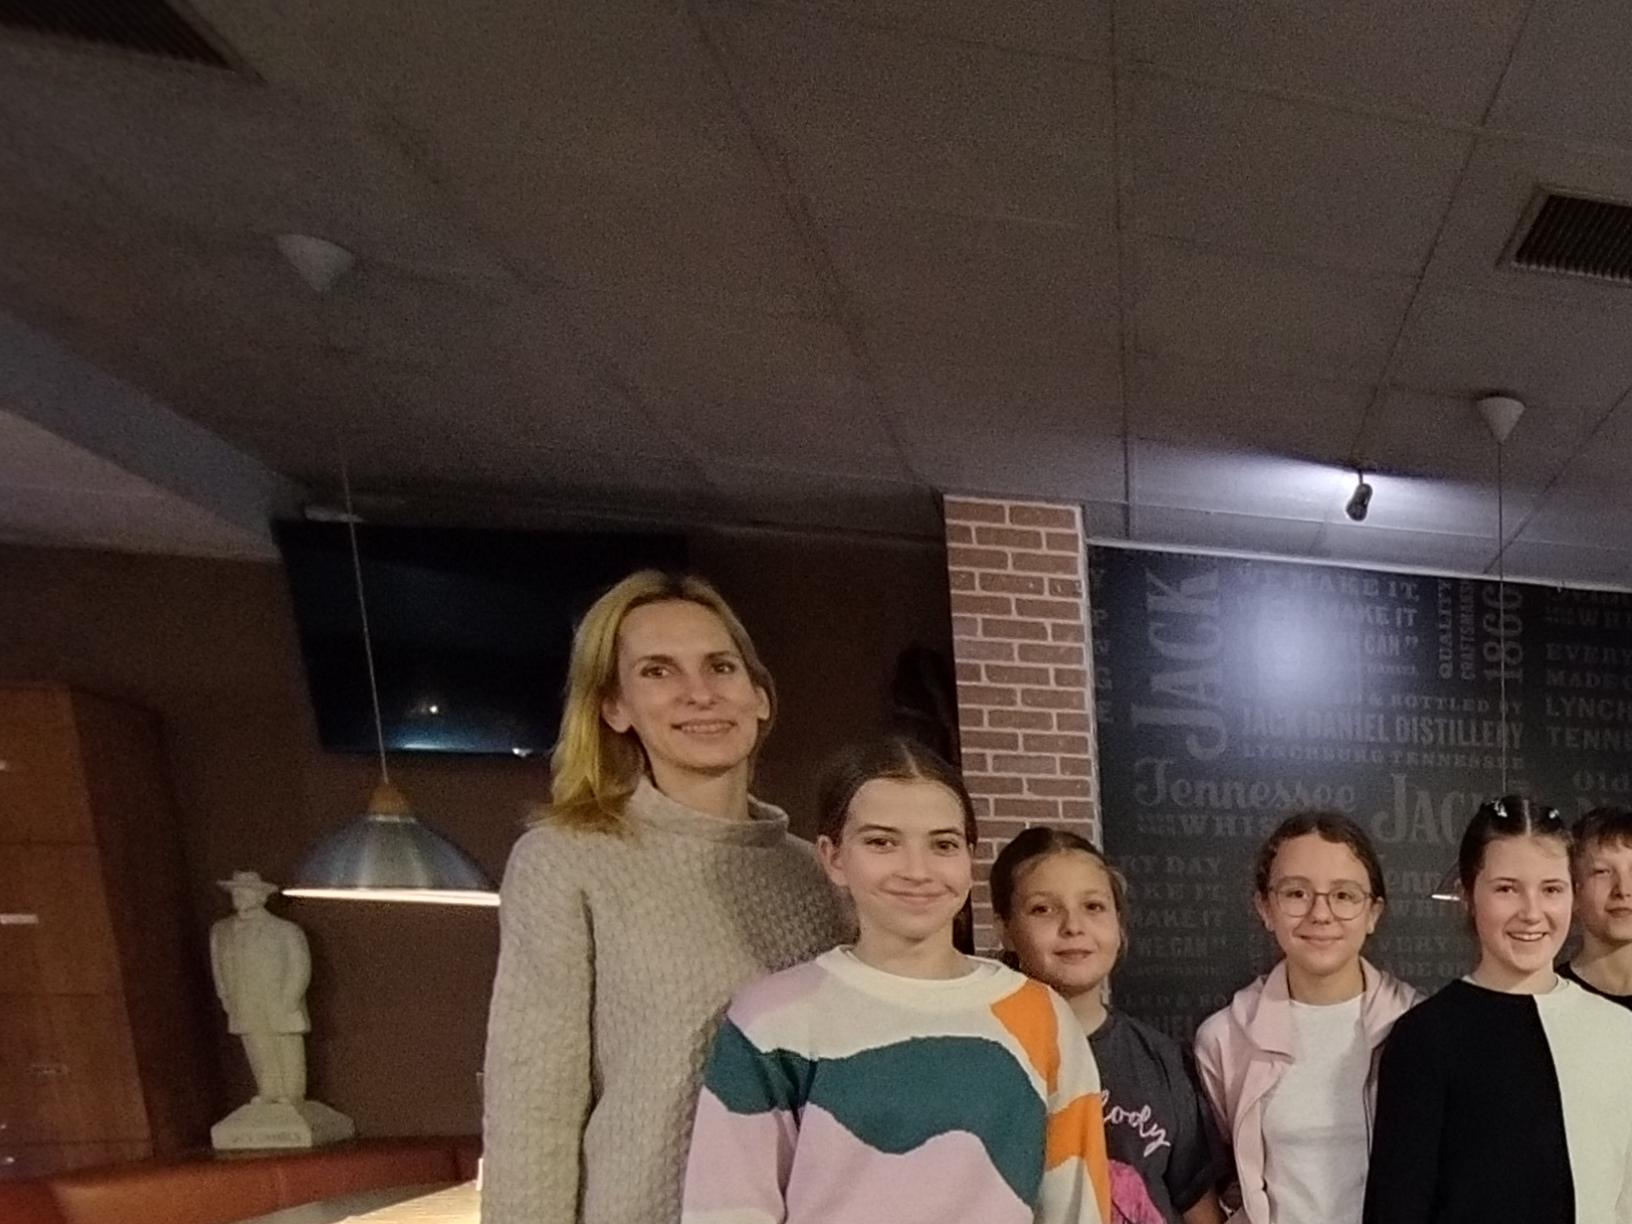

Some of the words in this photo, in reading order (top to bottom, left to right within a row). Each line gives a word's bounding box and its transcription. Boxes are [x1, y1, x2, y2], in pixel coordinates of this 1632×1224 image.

[1131, 567, 1228, 761] JACK
[1306, 710, 1391, 743] DANIEL
[1396, 714, 1523, 749] DISTILLERY
[1180, 814, 1279, 838] WHIS
